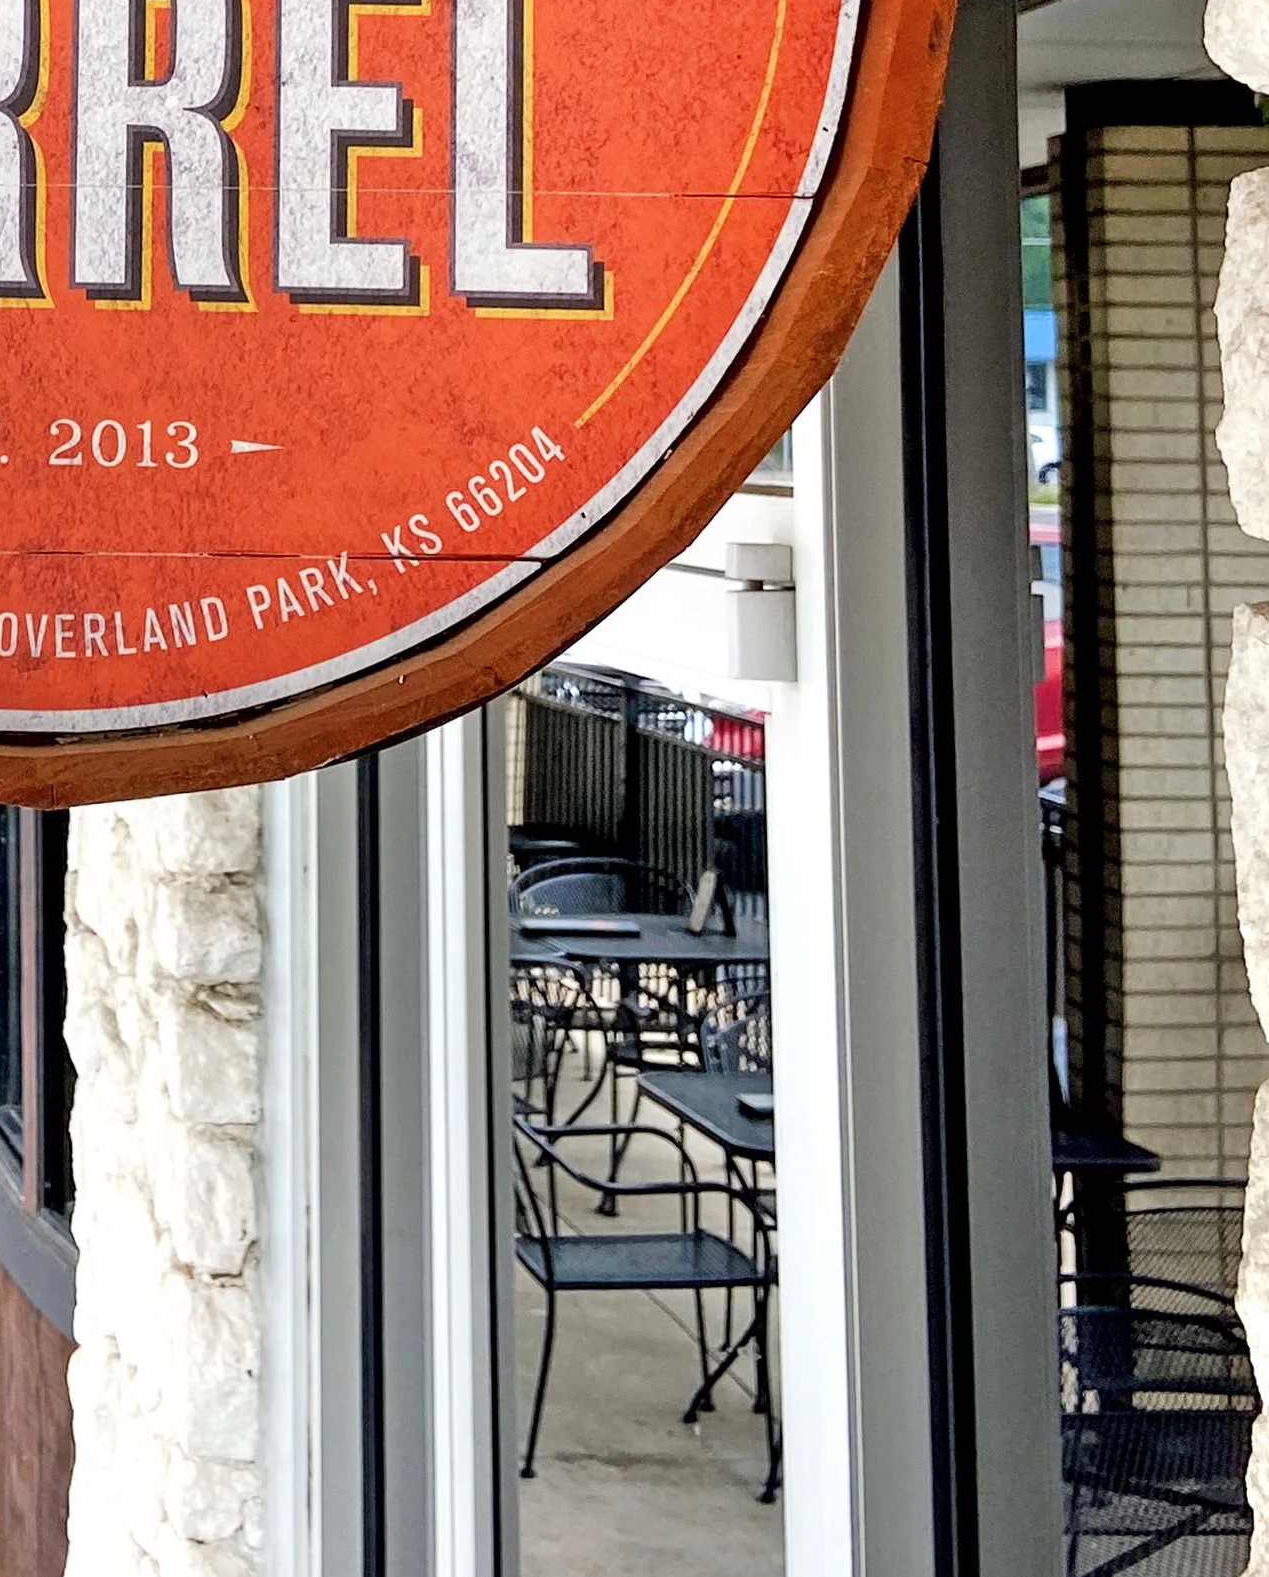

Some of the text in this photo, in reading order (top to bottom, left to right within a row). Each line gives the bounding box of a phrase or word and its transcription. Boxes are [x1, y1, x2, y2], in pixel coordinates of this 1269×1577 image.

[48, 418, 200, 469] 2013
[246, 550, 380, 631] PARK,
[381, 513, 444, 574] KS
[445, 425, 565, 534] 66204
